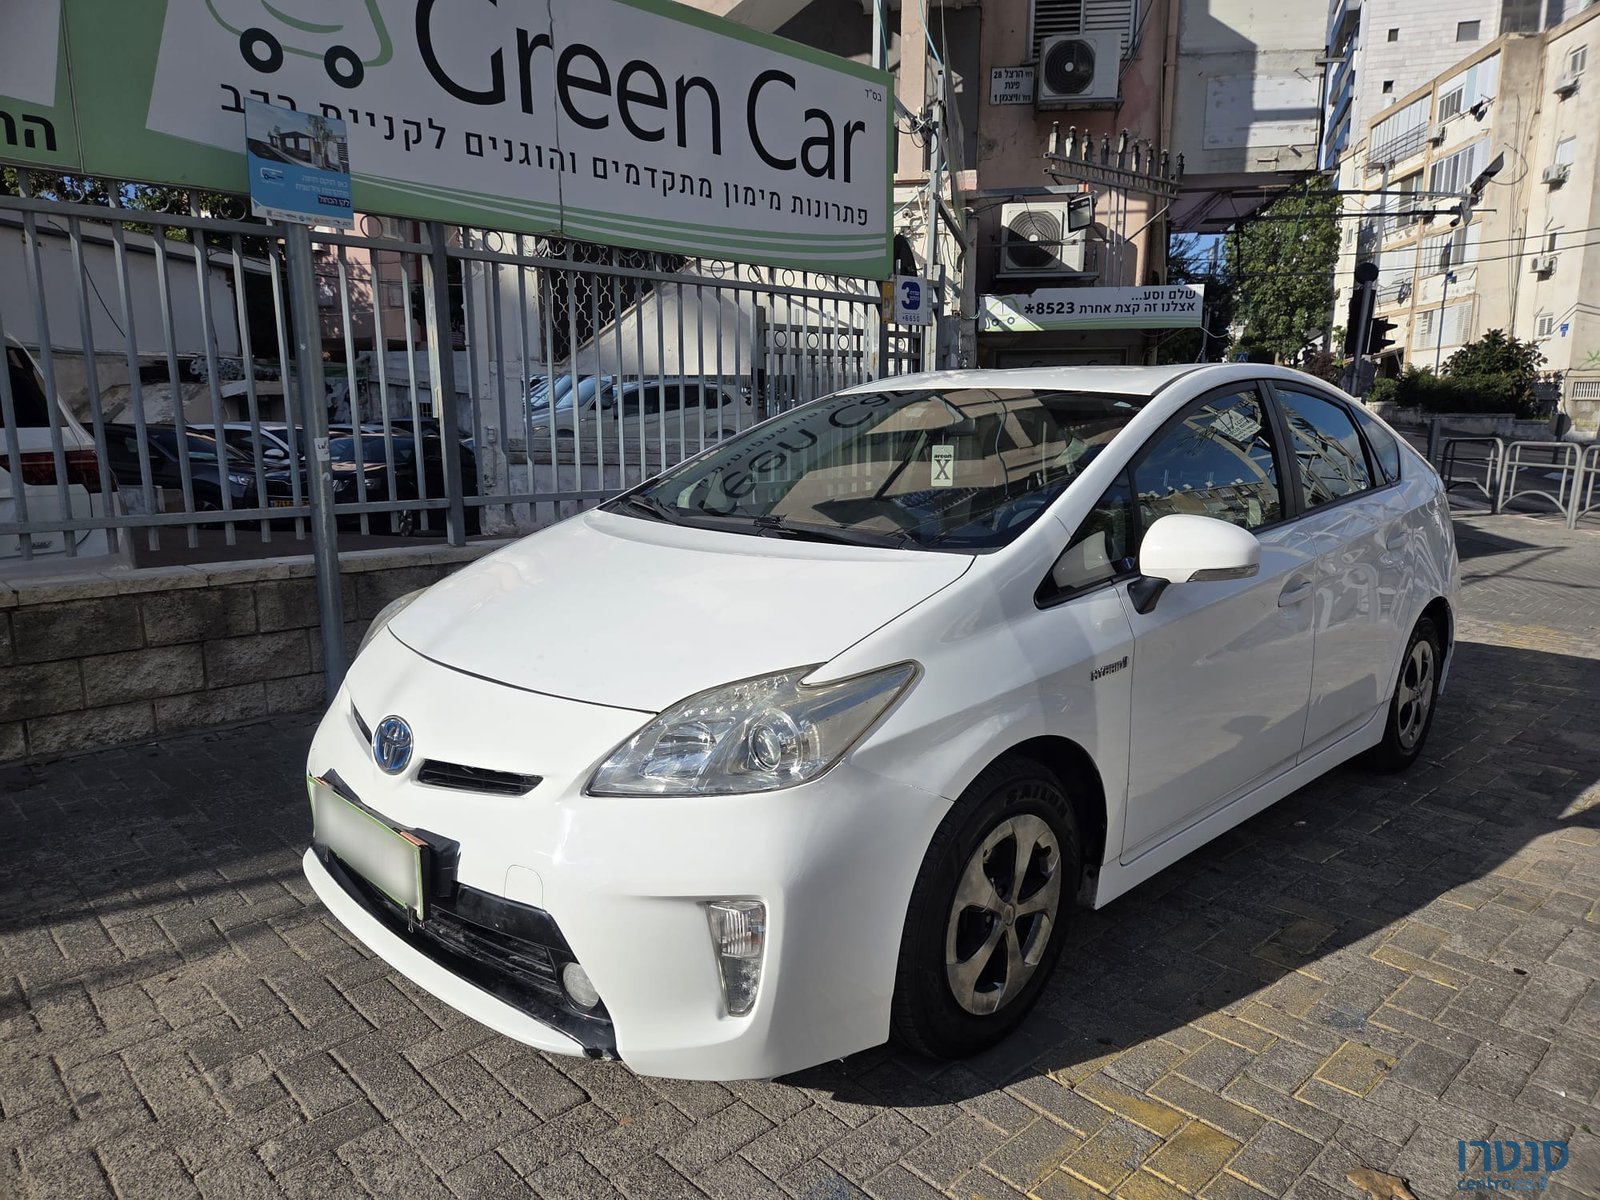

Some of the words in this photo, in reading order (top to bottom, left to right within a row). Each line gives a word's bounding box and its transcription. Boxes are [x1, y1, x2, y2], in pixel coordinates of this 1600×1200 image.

[993, 71, 1002, 79] 28
[1005, 69, 1023, 79] הרצל
[1004, 81, 1020, 90] פינת
[415, 0, 722, 156] Green
[746, 69, 866, 184] Car
[864, 88, 882, 102] בס"ד
[994, 94, 998, 102] 1
[465, 131, 577, 174] והוגנים
[592, 156, 712, 199] מתקדמים
[724, 182, 781, 211] מימון
[791, 195, 868, 226] פתרונות
[1131, 291, 1164, 301] וסע...
[1168, 289, 1196, 300] שלם
[1078, 304, 1112, 314] אחרת
[1115, 303, 1140, 315] קצת
[1144, 303, 1157, 312] זה
[1161, 301, 1195, 312] אצלנו
[934, 459, 951, 480] X
